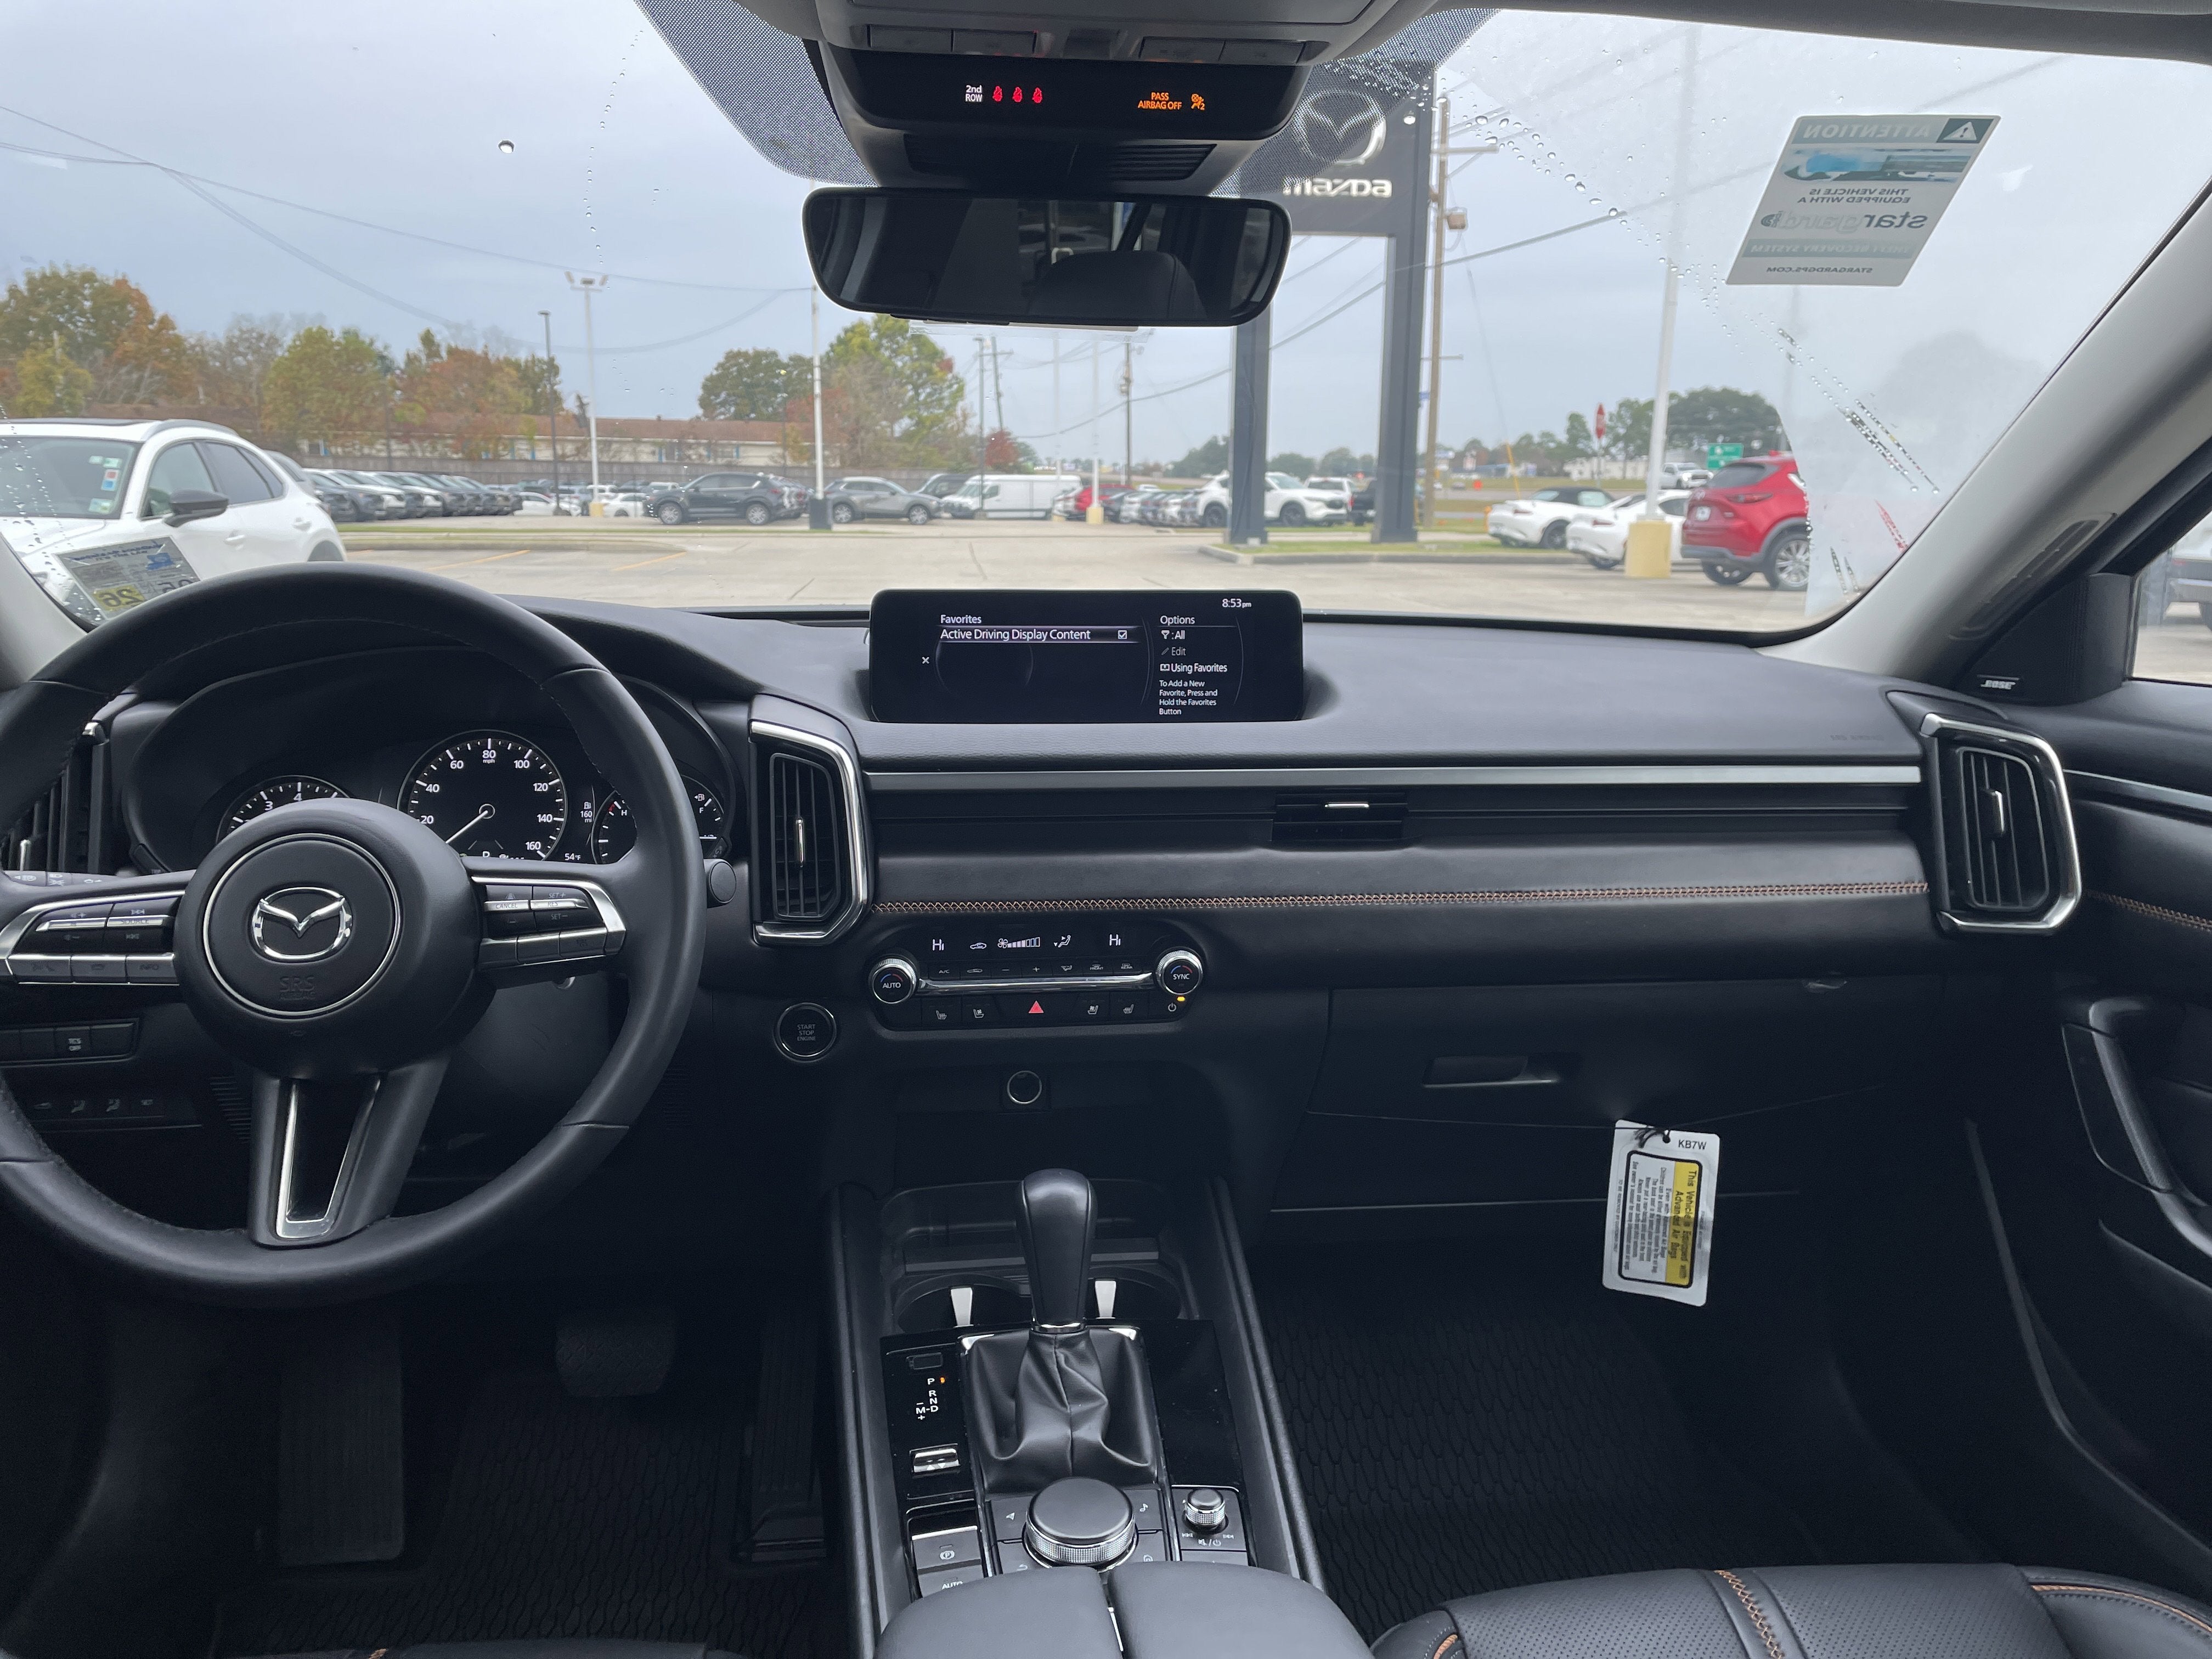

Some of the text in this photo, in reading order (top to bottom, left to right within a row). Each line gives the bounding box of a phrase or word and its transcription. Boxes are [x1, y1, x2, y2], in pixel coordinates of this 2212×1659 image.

[966, 84, 982, 93] 2nd
[966, 93, 983, 102] ROW
[1151, 92, 1169, 100] PASS
[1138, 100, 1182, 110] AIRBAG OFF
[940, 614, 982, 624] Favorites
[1160, 615, 1195, 626] Options
[940, 629, 1091, 641] Active Driving Display Content
[1171, 647, 1186, 656] Edit
[1171, 663, 1228, 674] Using Favorites
[482, 750, 496, 759] 80
[450, 760, 464, 769] 60
[514, 759, 530, 769] 100
[425, 783, 440, 793] 40
[533, 782, 548, 792] 120
[293, 793, 302, 801] 4
[265, 800, 273, 811] 3
[421, 815, 434, 825] 20
[537, 814, 553, 823] 140
[525, 841, 541, 850] 160
[1678, 1139, 1707, 1150] KB7W
[1687, 1170, 1697, 1187] This
[1685, 1190, 1695, 1217] Vehicle
